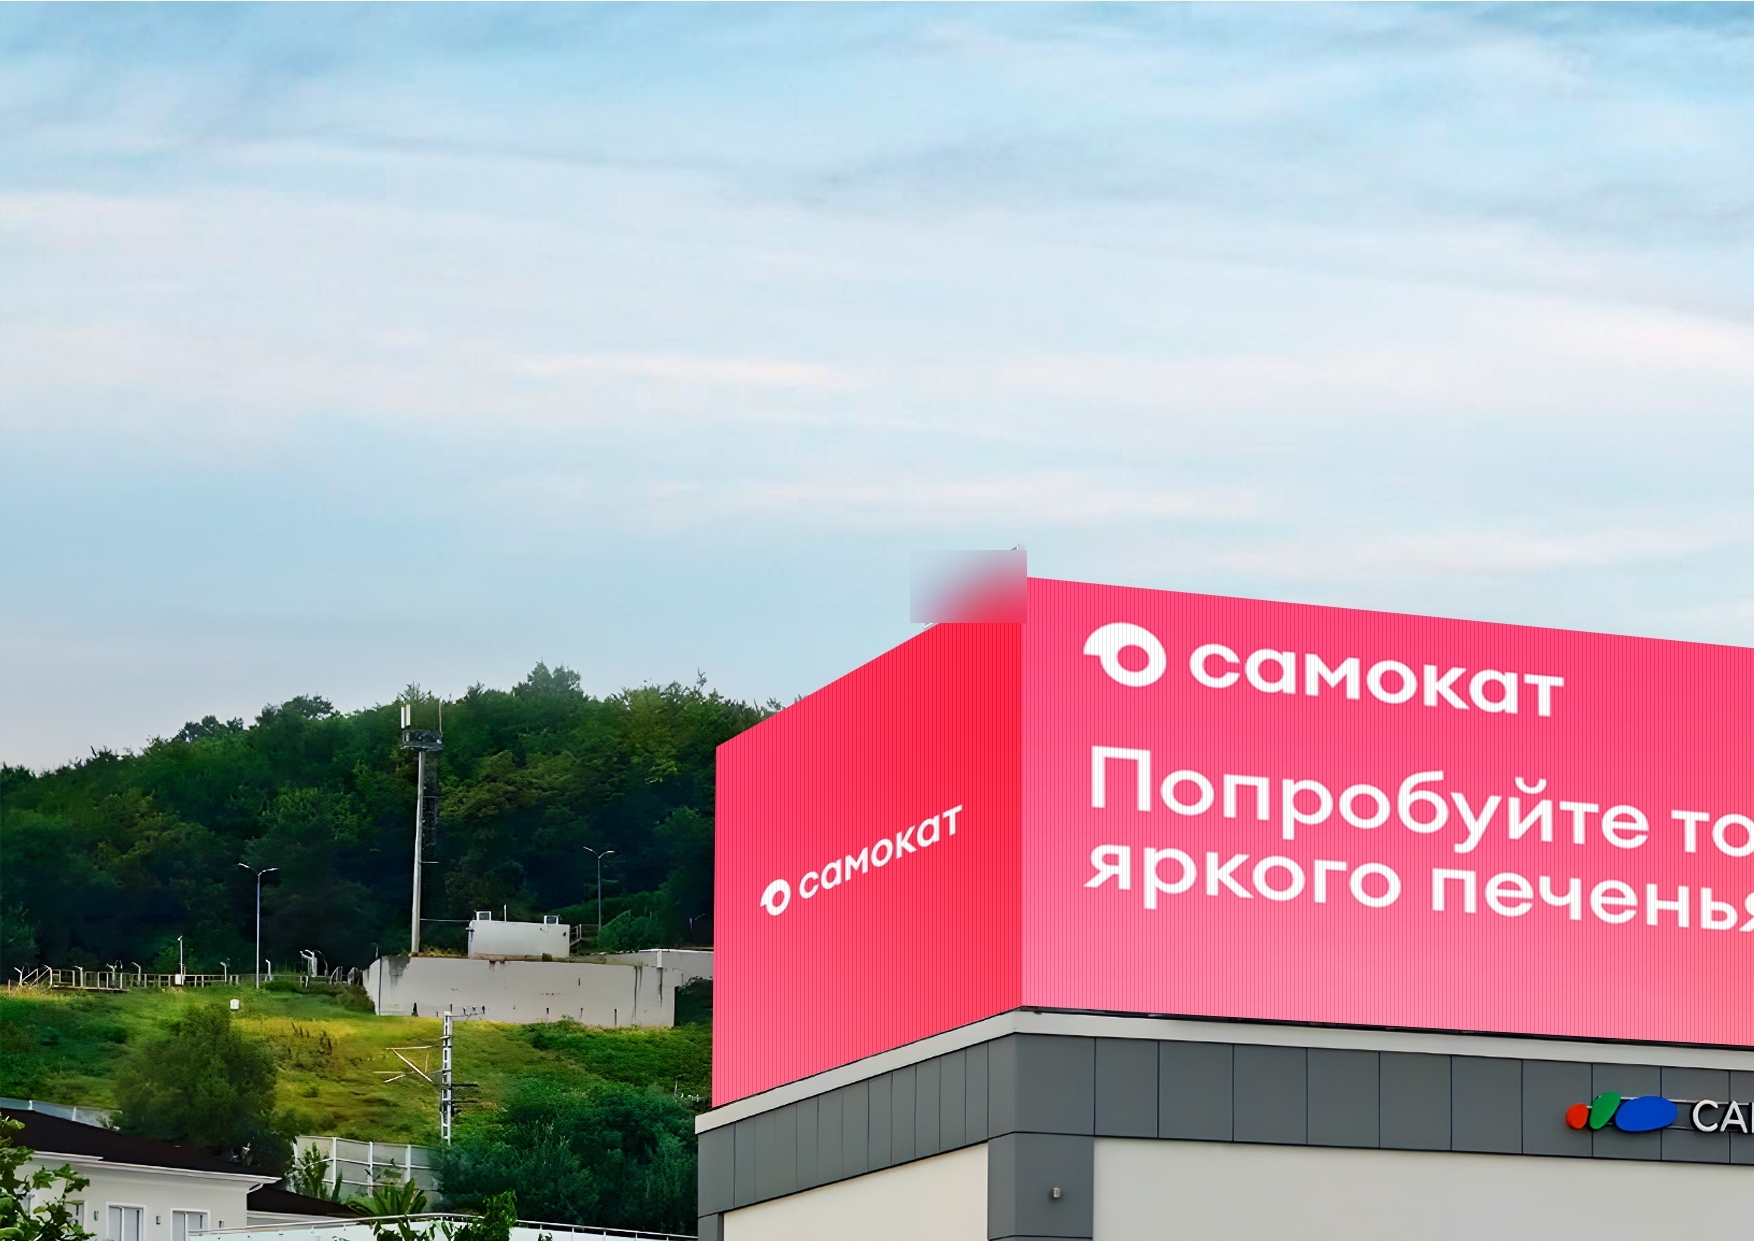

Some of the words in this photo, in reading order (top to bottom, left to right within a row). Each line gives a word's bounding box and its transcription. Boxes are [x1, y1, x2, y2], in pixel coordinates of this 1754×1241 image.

[1190, 643, 1564, 717] самокат
[1091, 745, 1649, 853] Попробуйте
[798, 804, 963, 899] самокат
[1084, 843, 1401, 910] яркого
